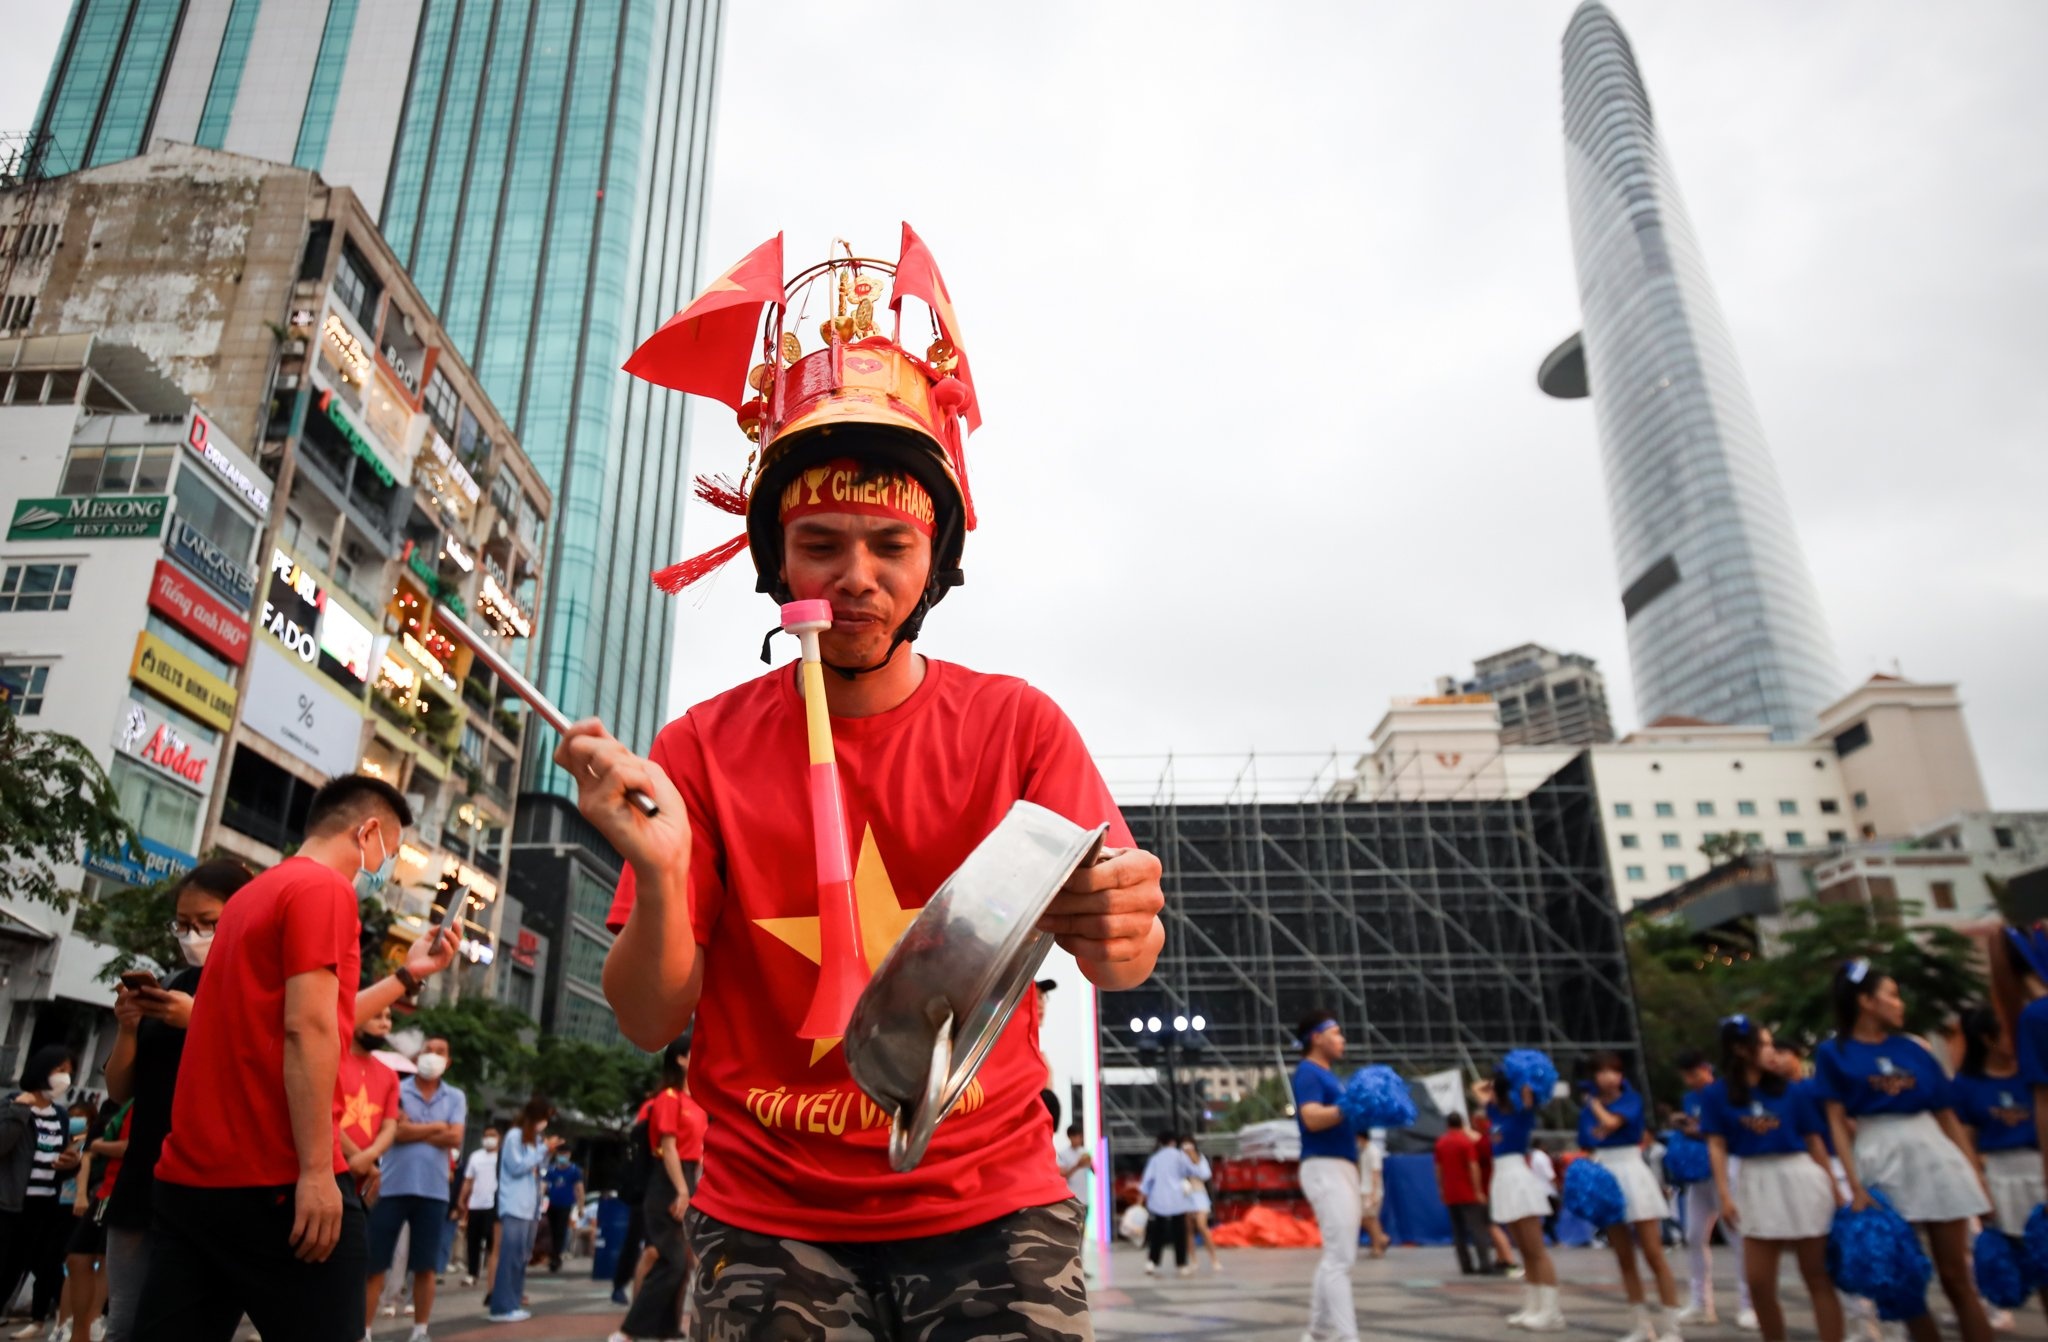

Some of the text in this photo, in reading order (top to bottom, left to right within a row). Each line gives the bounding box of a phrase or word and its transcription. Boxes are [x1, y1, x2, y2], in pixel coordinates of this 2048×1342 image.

[67, 498, 161, 518] MEKONG
[73, 522, 149, 536] REST STOP
[182, 524, 256, 597] LANCASTER
[260, 600, 316, 662] FADO
[157, 659, 183, 688] IELTS
[746, 1086, 794, 1128] TÔI
